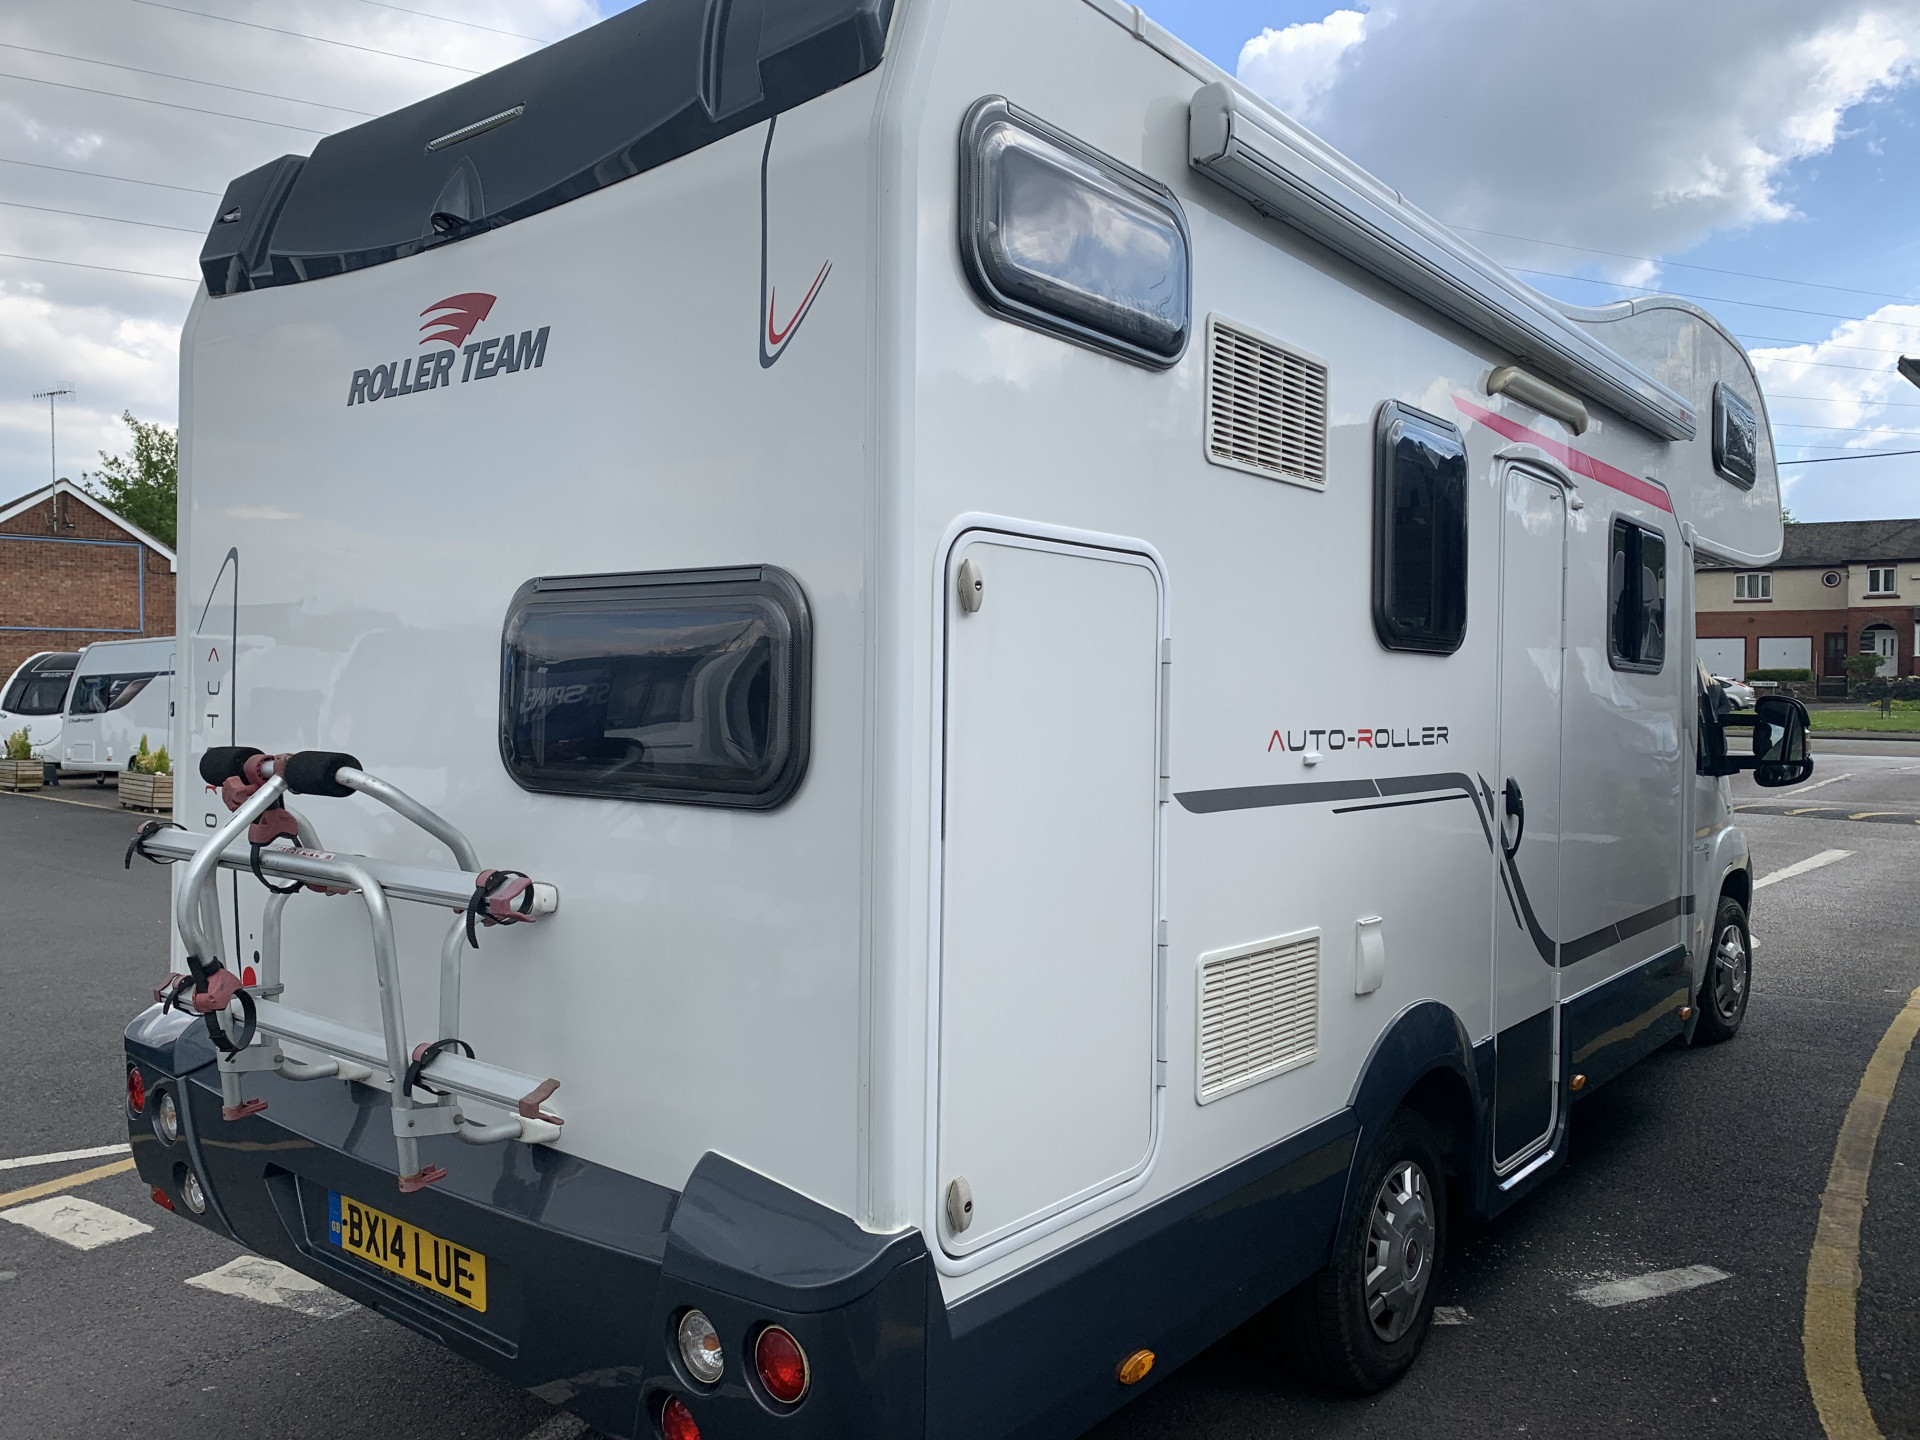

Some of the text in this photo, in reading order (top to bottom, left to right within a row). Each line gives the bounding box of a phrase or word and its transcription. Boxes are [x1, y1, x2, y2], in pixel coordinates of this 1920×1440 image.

[347, 326, 551, 406] ROLLER TEAM
[1268, 726, 1449, 752] AUTO-ROLLER
[348, 1203, 472, 1299] BX14 LUE
